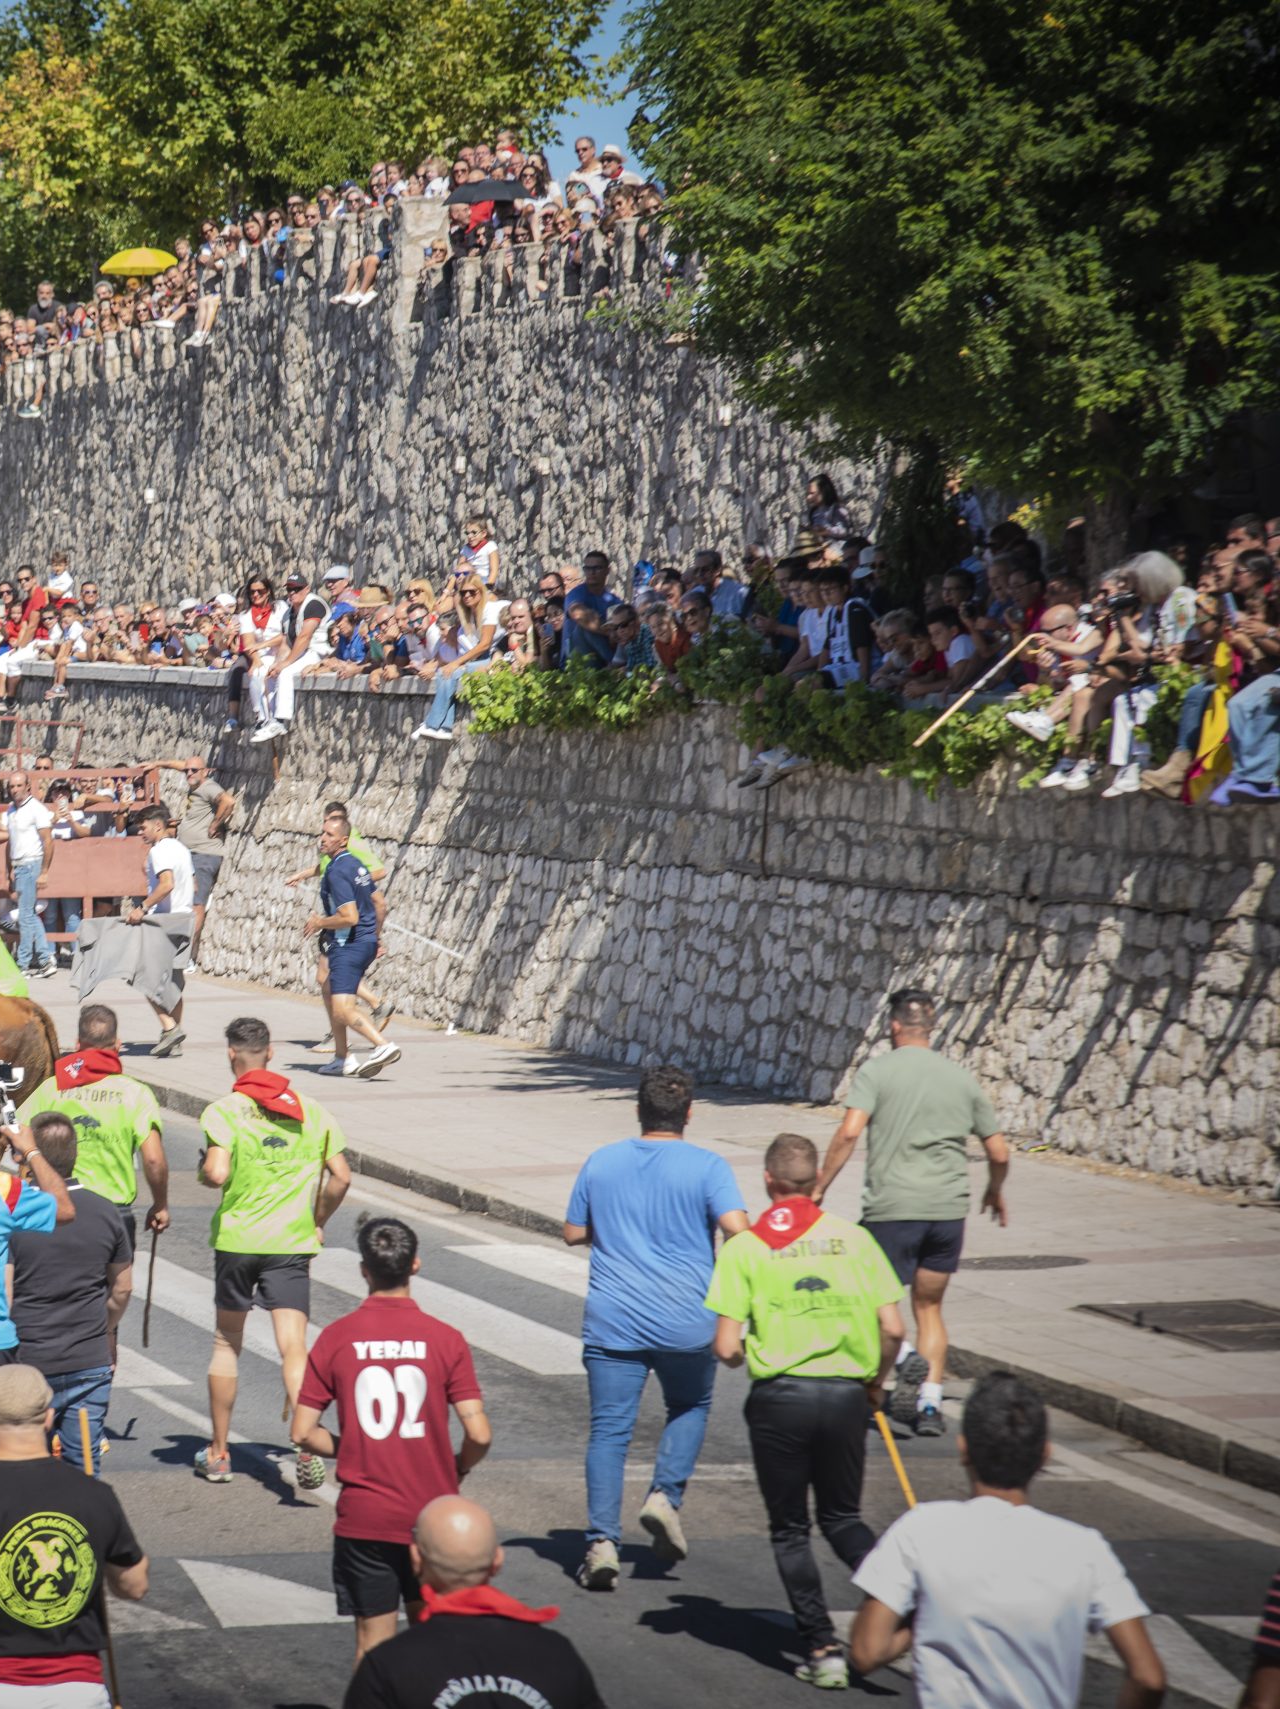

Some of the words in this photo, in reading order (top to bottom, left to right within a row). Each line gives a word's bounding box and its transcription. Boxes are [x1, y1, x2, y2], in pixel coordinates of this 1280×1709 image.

[351, 1340, 427, 1360] YERAI
[354, 1364, 428, 1441] 02
[471, 1674, 499, 1693] LA
